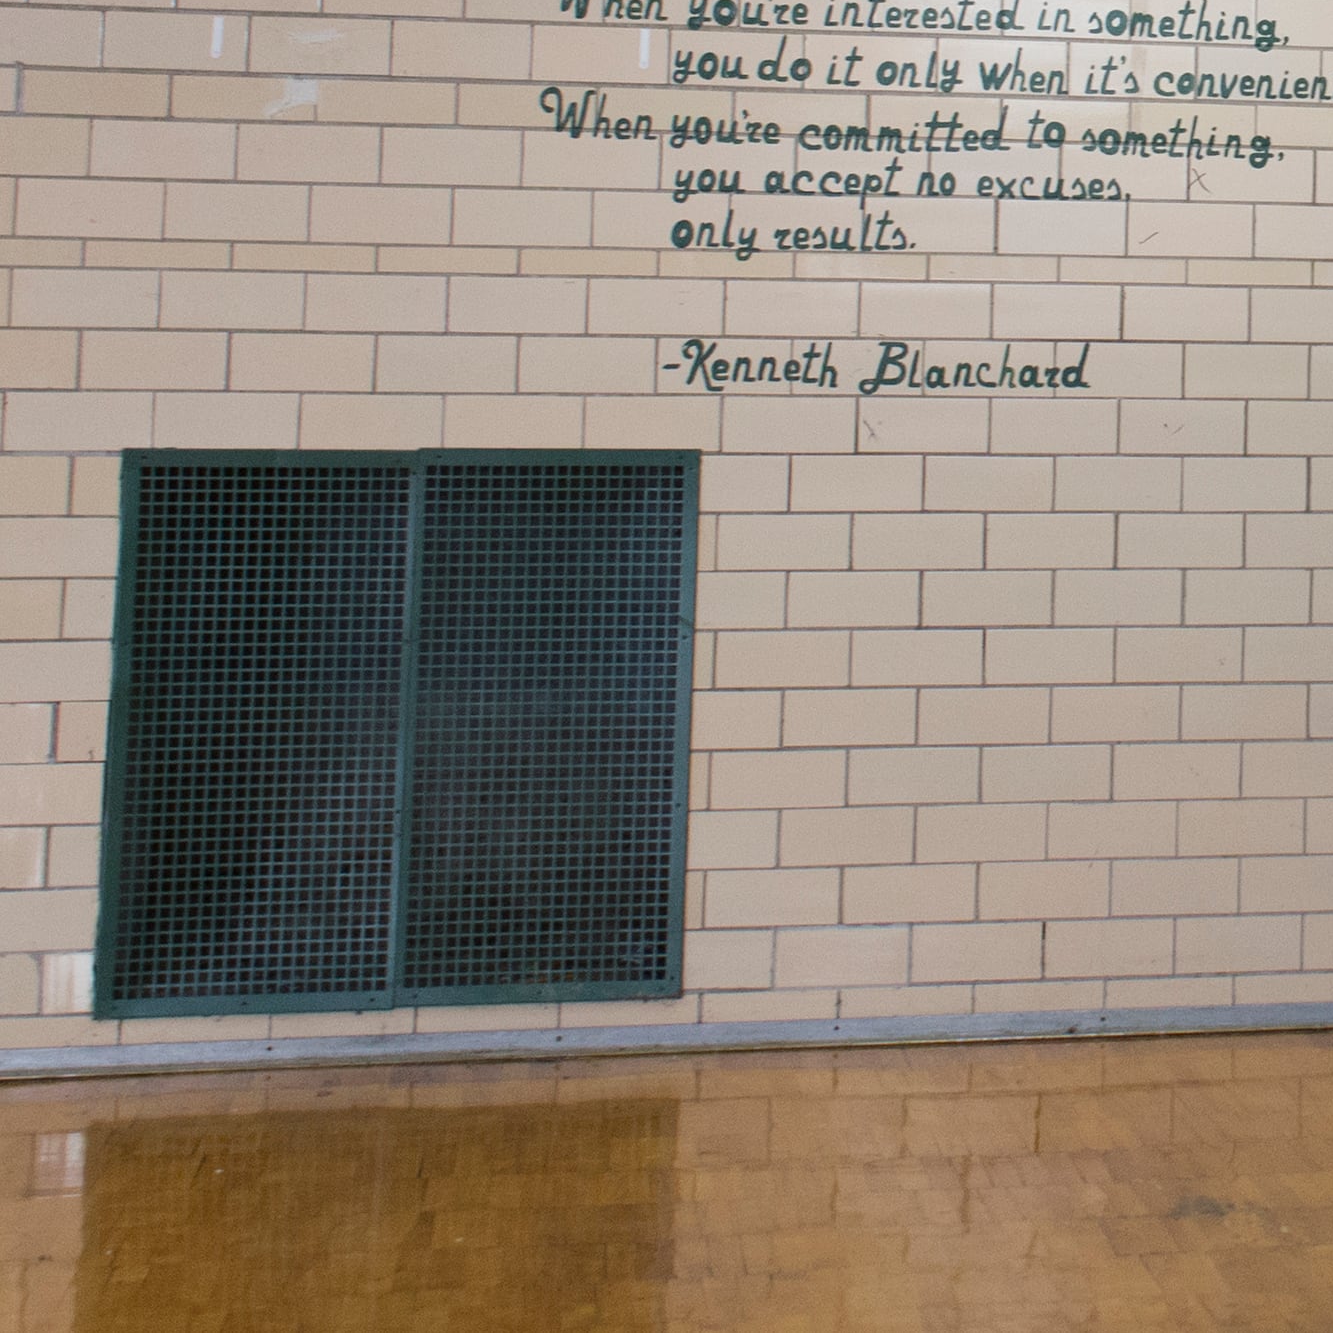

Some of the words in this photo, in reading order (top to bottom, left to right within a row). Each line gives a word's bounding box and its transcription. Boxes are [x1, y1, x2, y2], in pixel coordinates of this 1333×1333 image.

[1037, 0, 1075, 33] in
[673, 49, 748, 84] you
[757, 35, 812, 82] do
[825, 47, 863, 86] it
[876, 50, 963, 94] only
[979, 47, 1069, 94] when
[1084, 55, 1140, 95] it's
[539, 87, 657, 139] When
[668, 109, 781, 148] you're
[798, 105, 1010, 153] committed
[1026, 104, 1065, 149] to
[1081, 115, 1285, 169] something,
[672, 167, 745, 203] you
[764, 157, 904, 210] accept
[915, 171, 956, 197] no
[976, 175, 1132, 202] excuses,
[670, 208, 759, 261] only
[773, 209, 918, 252] results.
[858, 341, 1091, 395] Blanchard
